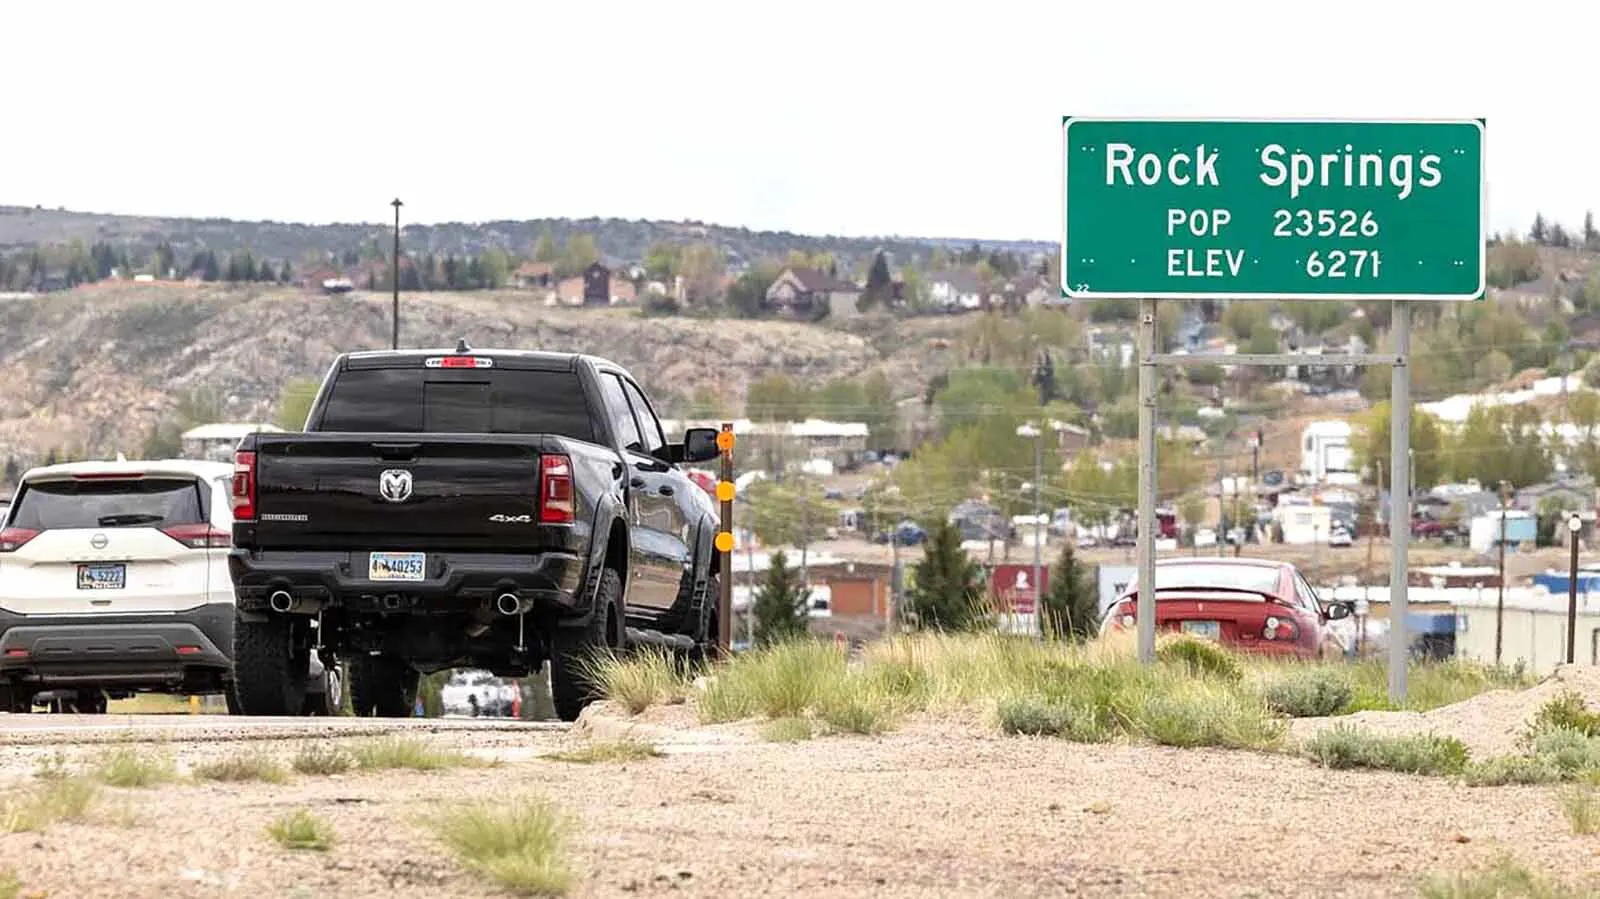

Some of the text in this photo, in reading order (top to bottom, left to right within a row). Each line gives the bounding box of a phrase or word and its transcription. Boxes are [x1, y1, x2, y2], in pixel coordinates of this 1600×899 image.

[1106, 143, 1442, 200] Rock Springs
[1167, 209, 1379, 237] POP 23526
[1167, 249, 1380, 278] ELEV 6271
